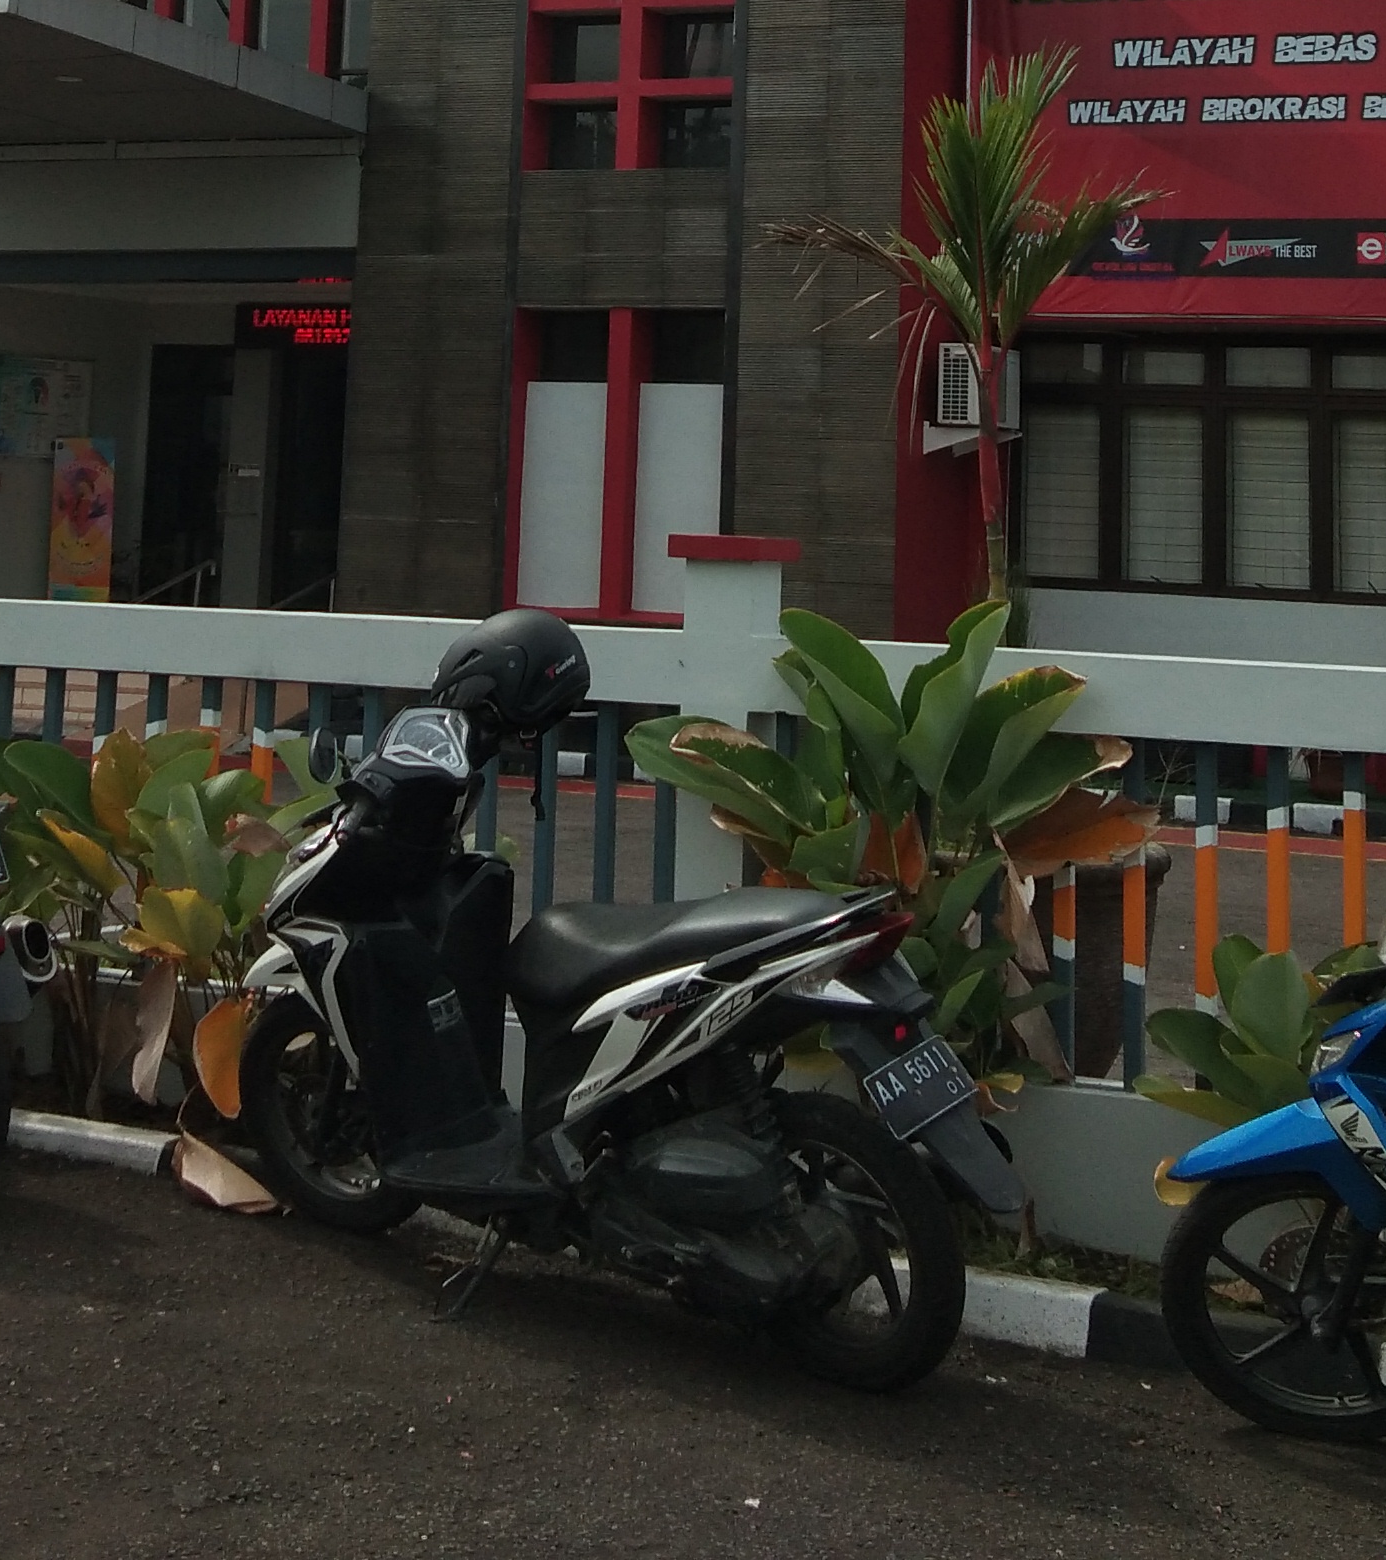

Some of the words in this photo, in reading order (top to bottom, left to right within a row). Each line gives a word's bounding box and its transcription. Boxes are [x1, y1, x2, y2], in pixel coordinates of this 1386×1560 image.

[1113, 37, 1255, 68] WILAYAH
[1274, 33, 1378, 63] BEBAS
[1069, 99, 1186, 125] WILAYAH
[1201, 96, 1346, 123] BIROKRASI
[1274, 246, 1292, 258] THE
[1294, 244, 1318, 258] BEST
[253, 309, 337, 328] LAYANAN
[875, 1071, 907, 1107] AA
[903, 1045, 949, 1085] 5611
